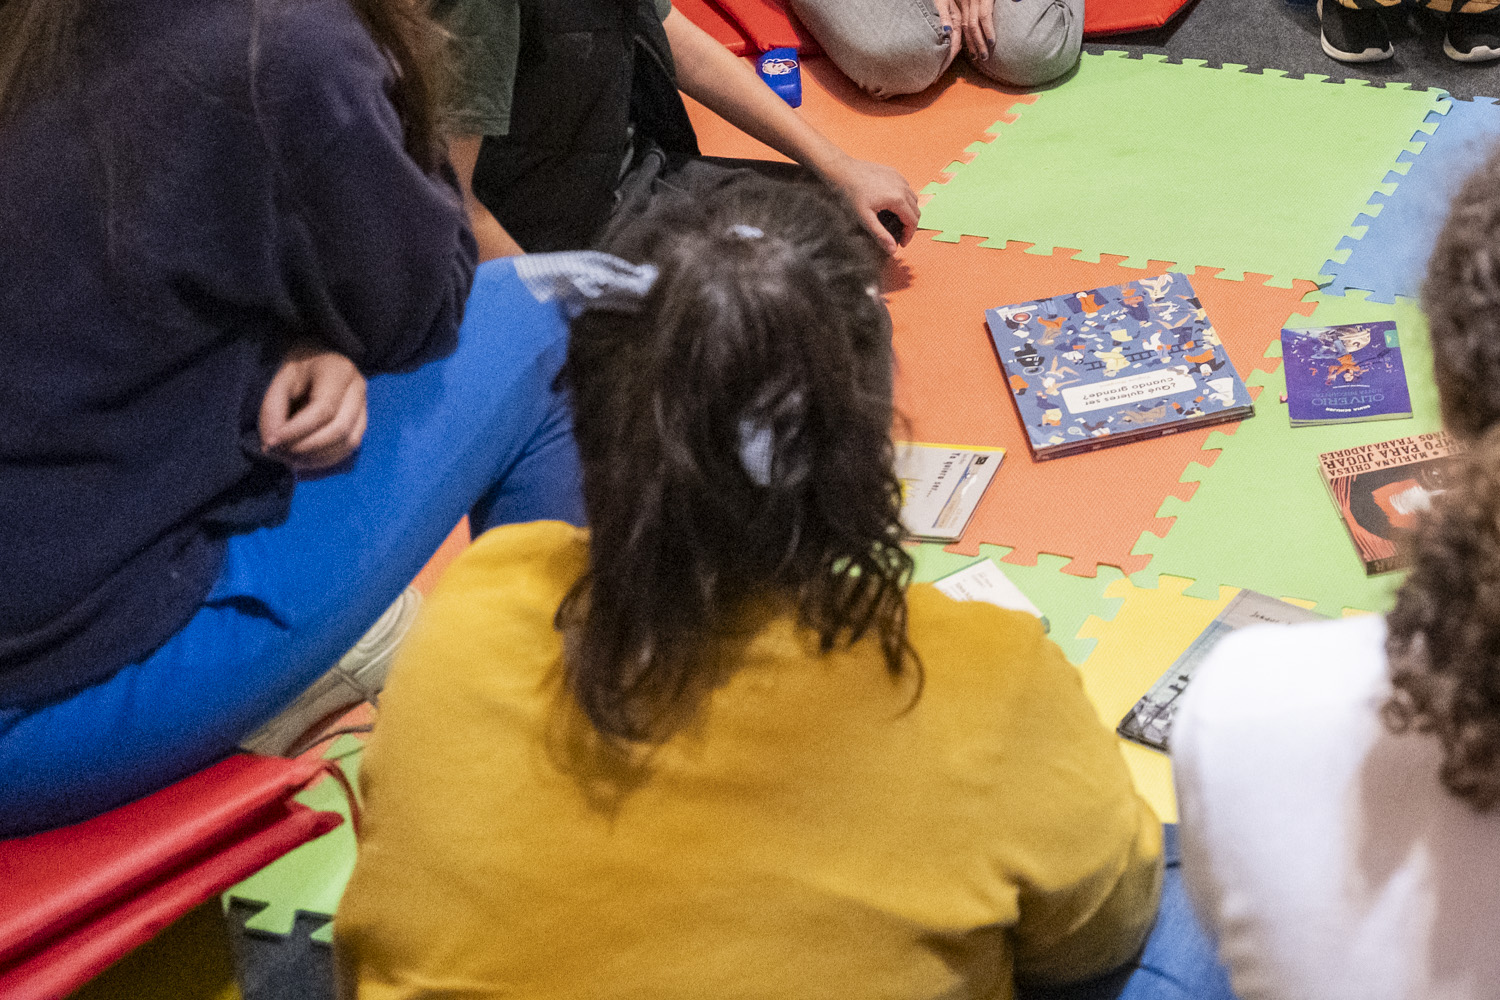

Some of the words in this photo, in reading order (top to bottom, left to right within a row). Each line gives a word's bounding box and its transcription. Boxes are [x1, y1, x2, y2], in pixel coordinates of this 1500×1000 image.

[1132, 377, 1174, 390] cuando
[1148, 382, 1176, 394] ¿Qué
[1083, 386, 1128, 400] grande?
[1104, 390, 1144, 402] quieres
[1312, 394, 1385, 406] OLIVERIO
[1320, 437, 1414, 460] TRABAJADORES
[1380, 444, 1420, 458] PARA
[1324, 453, 1374, 470] JUGAR
[1375, 452, 1428, 466] MARIANA
[938, 461, 953, 480] quiero
[1328, 464, 1371, 476] CHIESA
